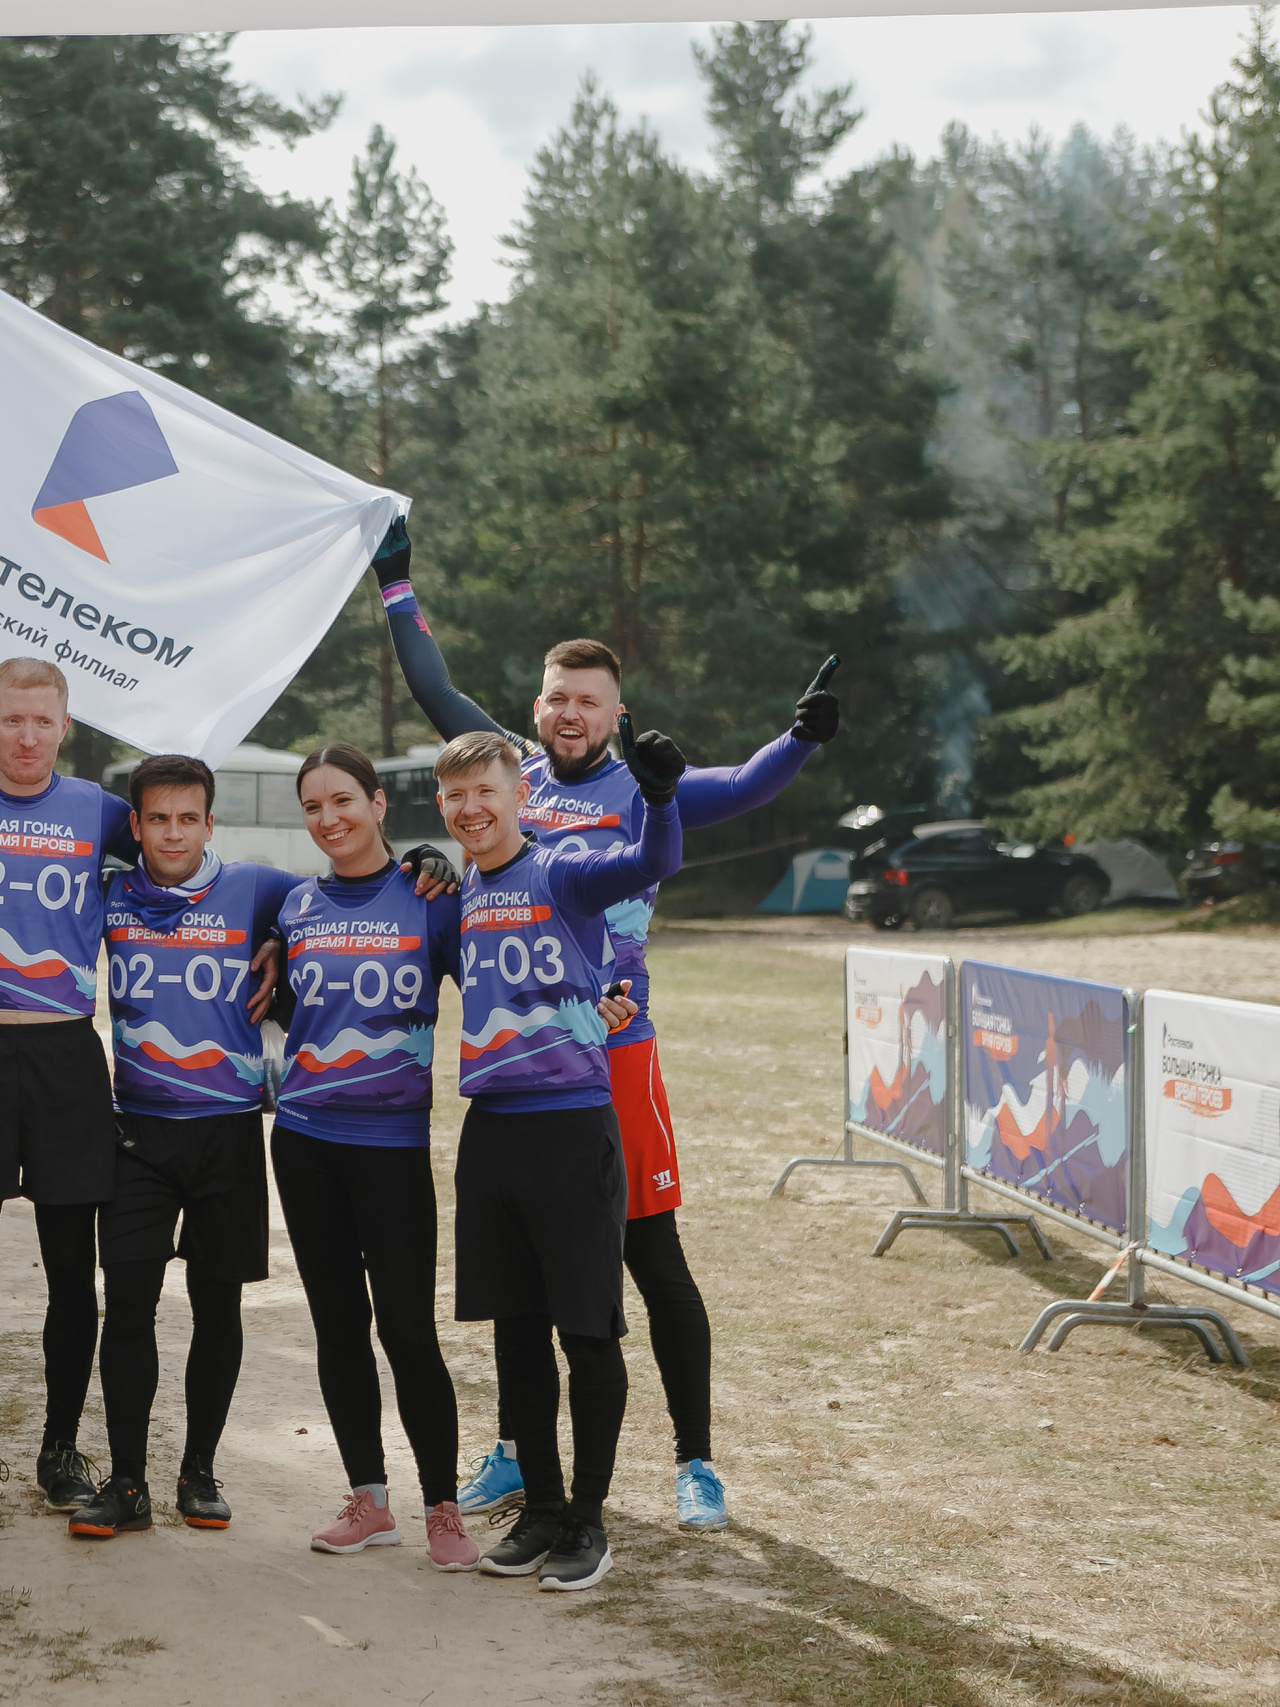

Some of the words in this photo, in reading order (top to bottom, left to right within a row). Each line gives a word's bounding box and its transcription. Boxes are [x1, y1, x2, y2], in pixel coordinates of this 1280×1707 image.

[54, 639, 140, 692] филиал
[558, 798, 604, 816] ГОНКА
[555, 812, 600, 826] ГЕРОЕВ
[23, 820, 74, 839] ГОНКА
[23, 836, 75, 853] ГЕРОЕВ
[489, 891, 531, 906] ГОНКА
[181, 912, 226, 928] ОНКА
[489, 908, 532, 922] ГЕРОЕВ
[350, 920, 400, 936] ГОНКА
[305, 936, 347, 951] ВРЕМЯ
[348, 936, 400, 949] ГЕРОЕВ
[110, 953, 250, 1002] 02-07
